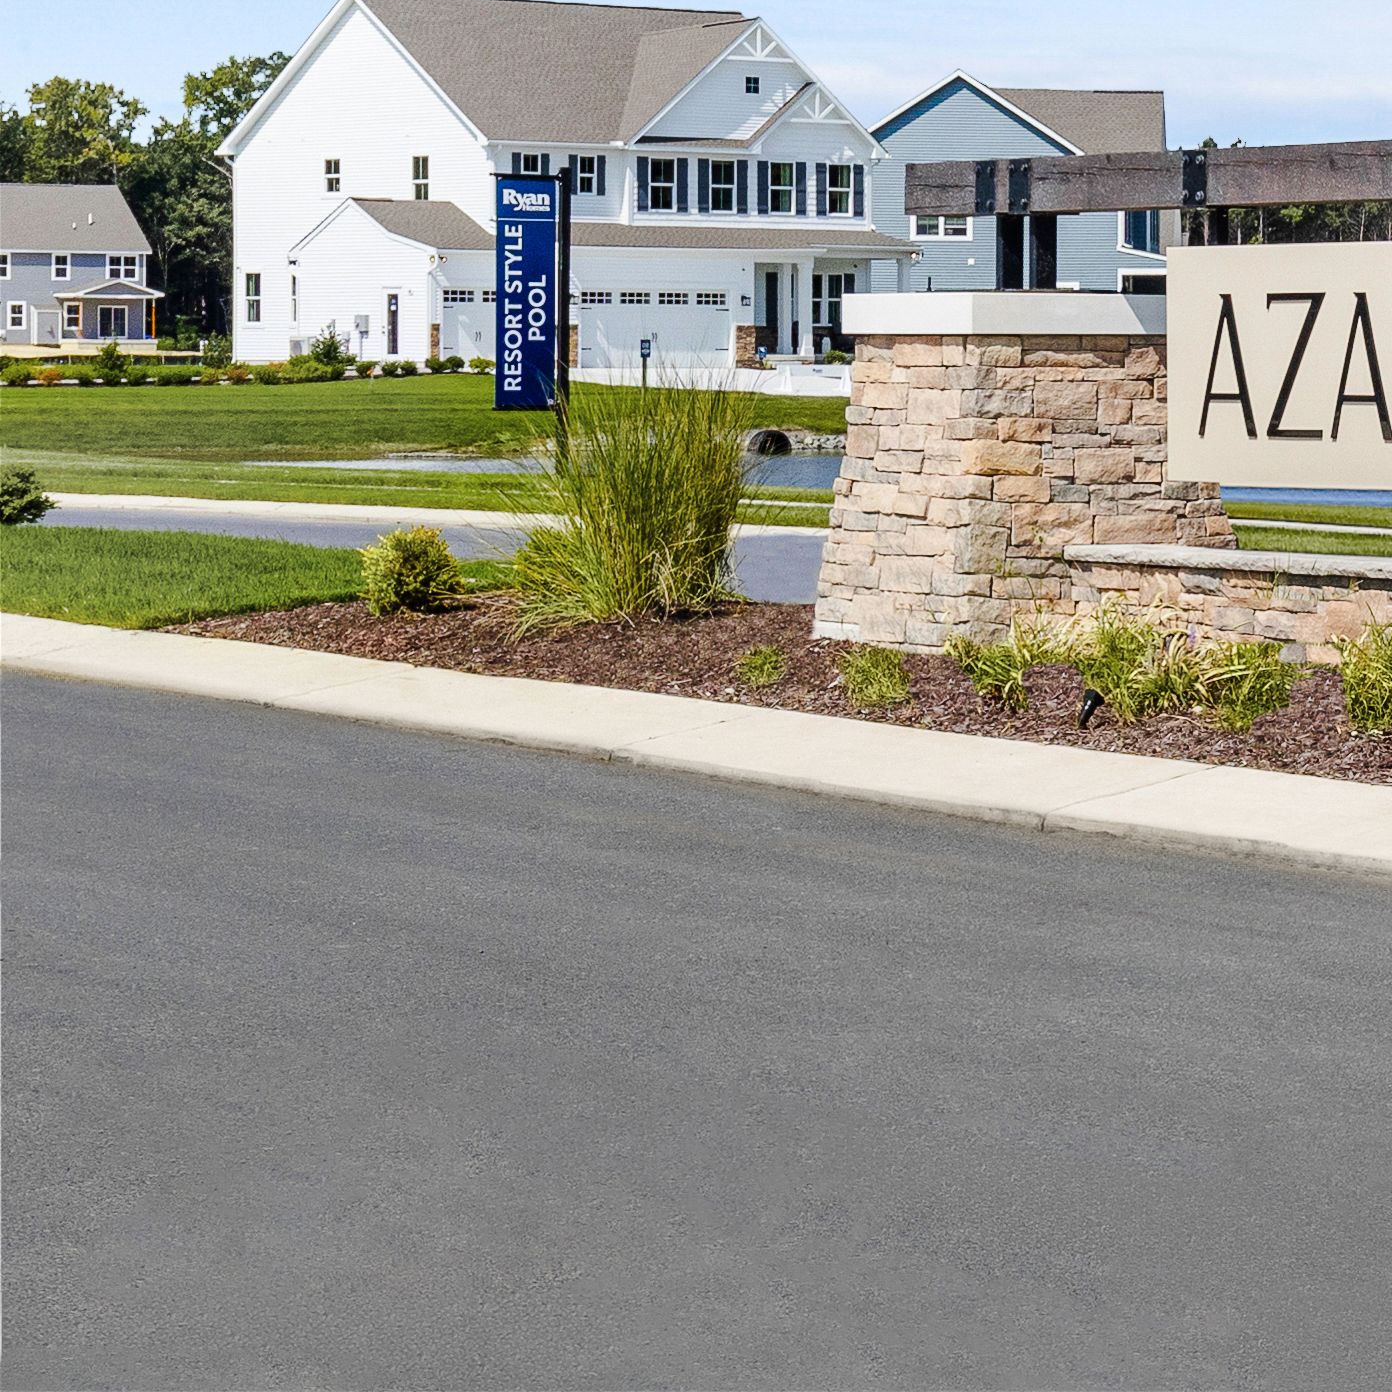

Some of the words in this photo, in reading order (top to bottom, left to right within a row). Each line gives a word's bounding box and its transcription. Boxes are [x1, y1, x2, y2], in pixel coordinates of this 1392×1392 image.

[502, 188, 550, 211] Ryan
[504, 224, 523, 294] STYLE
[528, 274, 547, 341] POOL
[503, 298, 523, 391] RESORT
